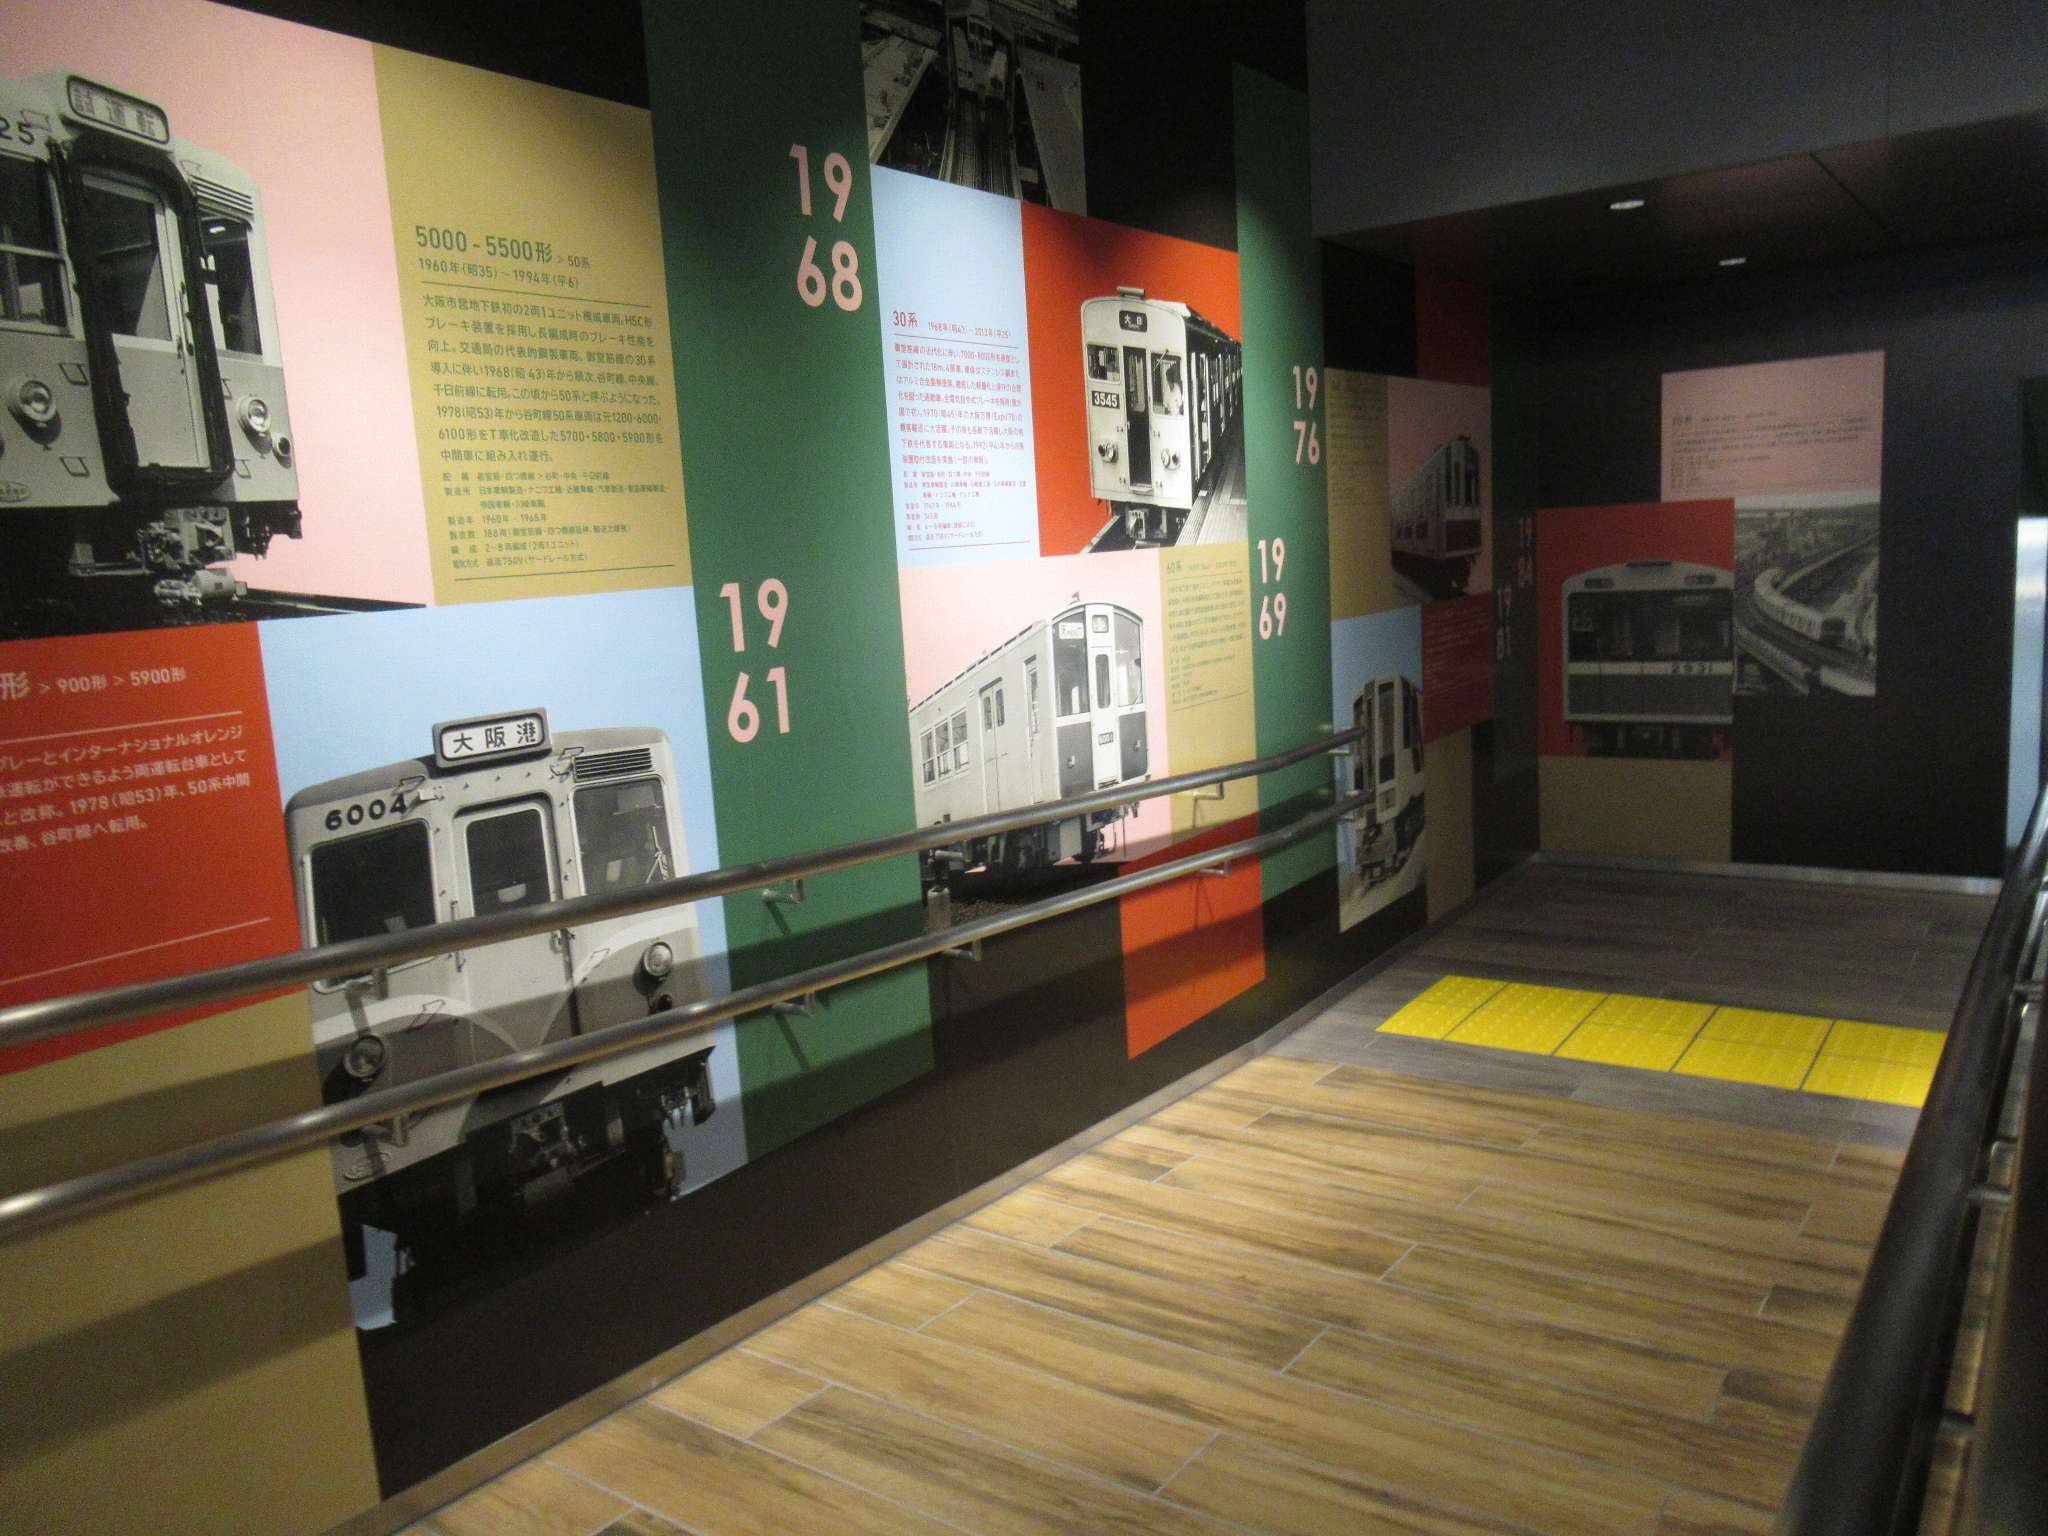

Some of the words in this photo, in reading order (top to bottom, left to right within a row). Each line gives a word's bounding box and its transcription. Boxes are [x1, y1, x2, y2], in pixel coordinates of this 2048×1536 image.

[789, 144, 852, 222] 19
[415, 225, 468, 252] 5000
[485, 235, 553, 264] 5500形
[797, 235, 863, 312] 68
[892, 311, 918, 328] 30系
[1094, 392, 1118, 408] 3545
[1293, 366, 1317, 409] 19
[1293, 421, 1320, 464] 76
[1257, 537, 1285, 584] 19
[720, 578, 788, 652] 19
[1259, 592, 1286, 640] 69
[57, 674, 107, 693] 900形
[130, 667, 186, 686] 5900形
[728, 666, 790, 743] 61
[453, 722, 537, 753] 大阪港
[325, 794, 408, 830] 6004
